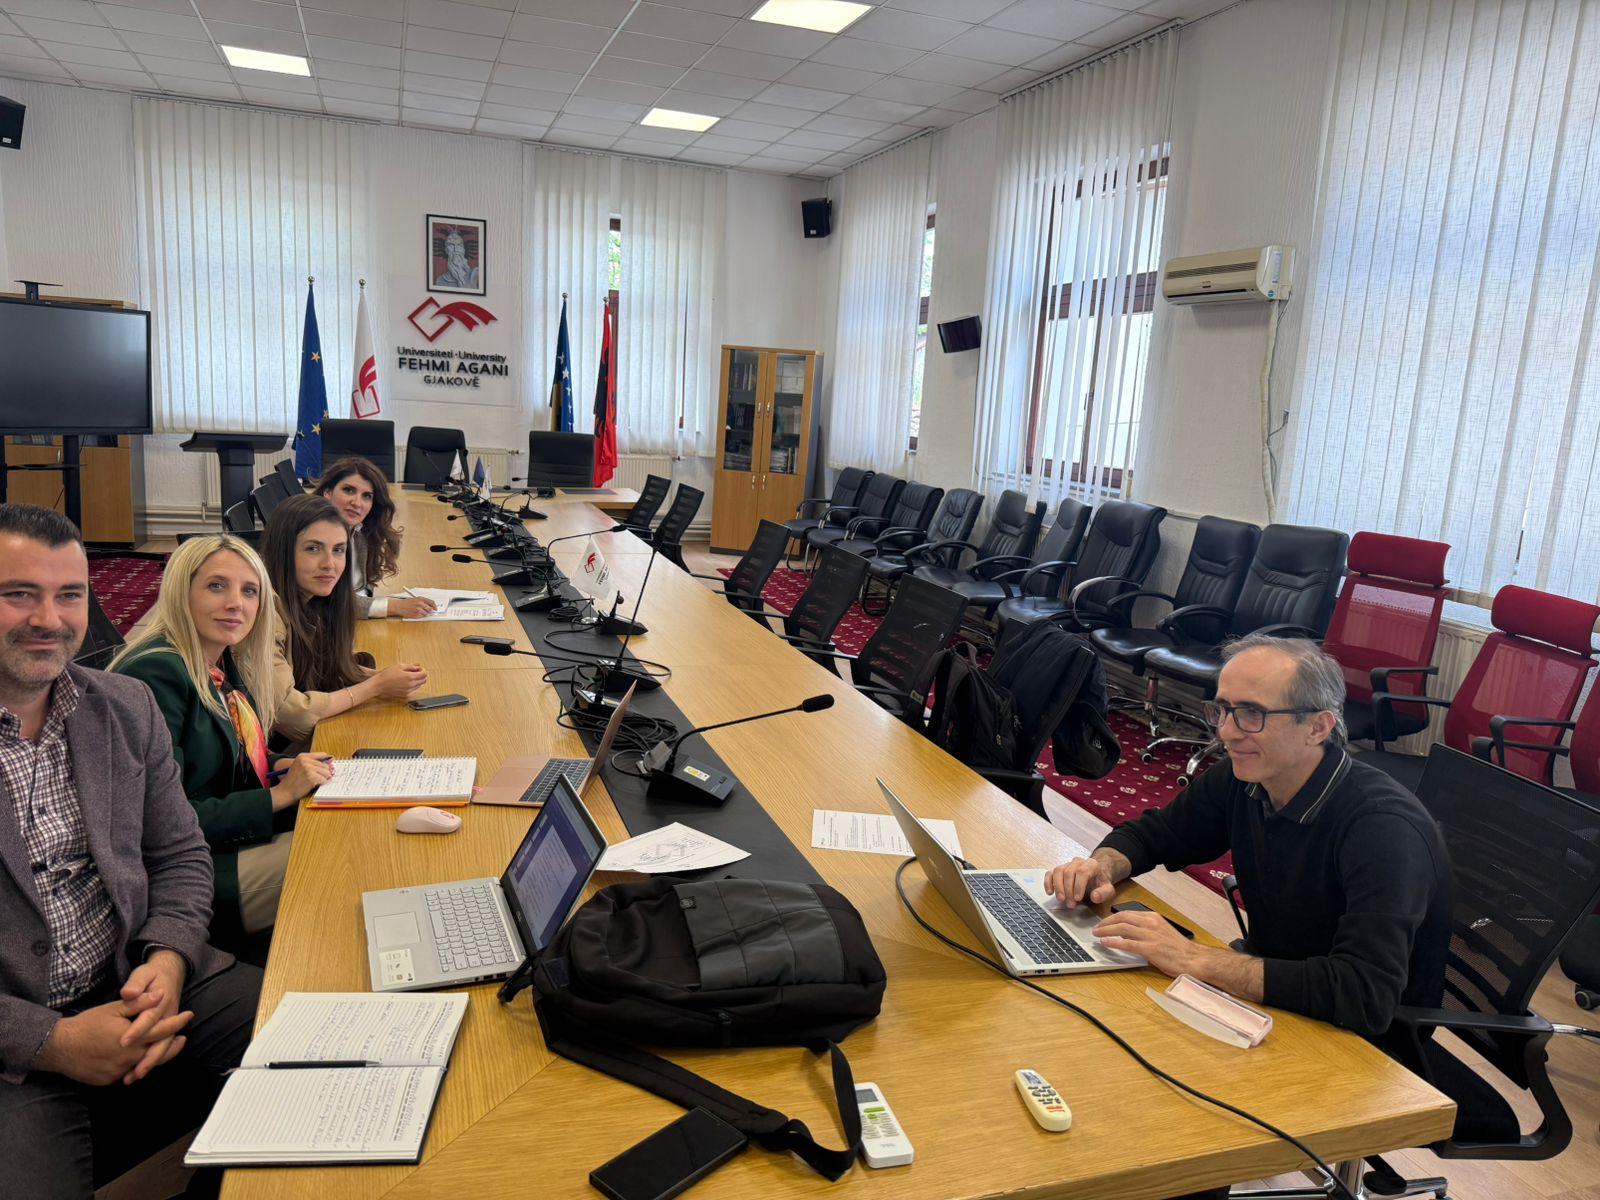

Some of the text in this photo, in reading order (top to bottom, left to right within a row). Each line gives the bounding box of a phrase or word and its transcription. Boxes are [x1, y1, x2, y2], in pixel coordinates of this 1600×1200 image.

[397, 346, 454, 359] Universiteti
[398, 357, 509, 377] FEHMI AGANI
[423, 375, 480, 387] GJAKOVË
